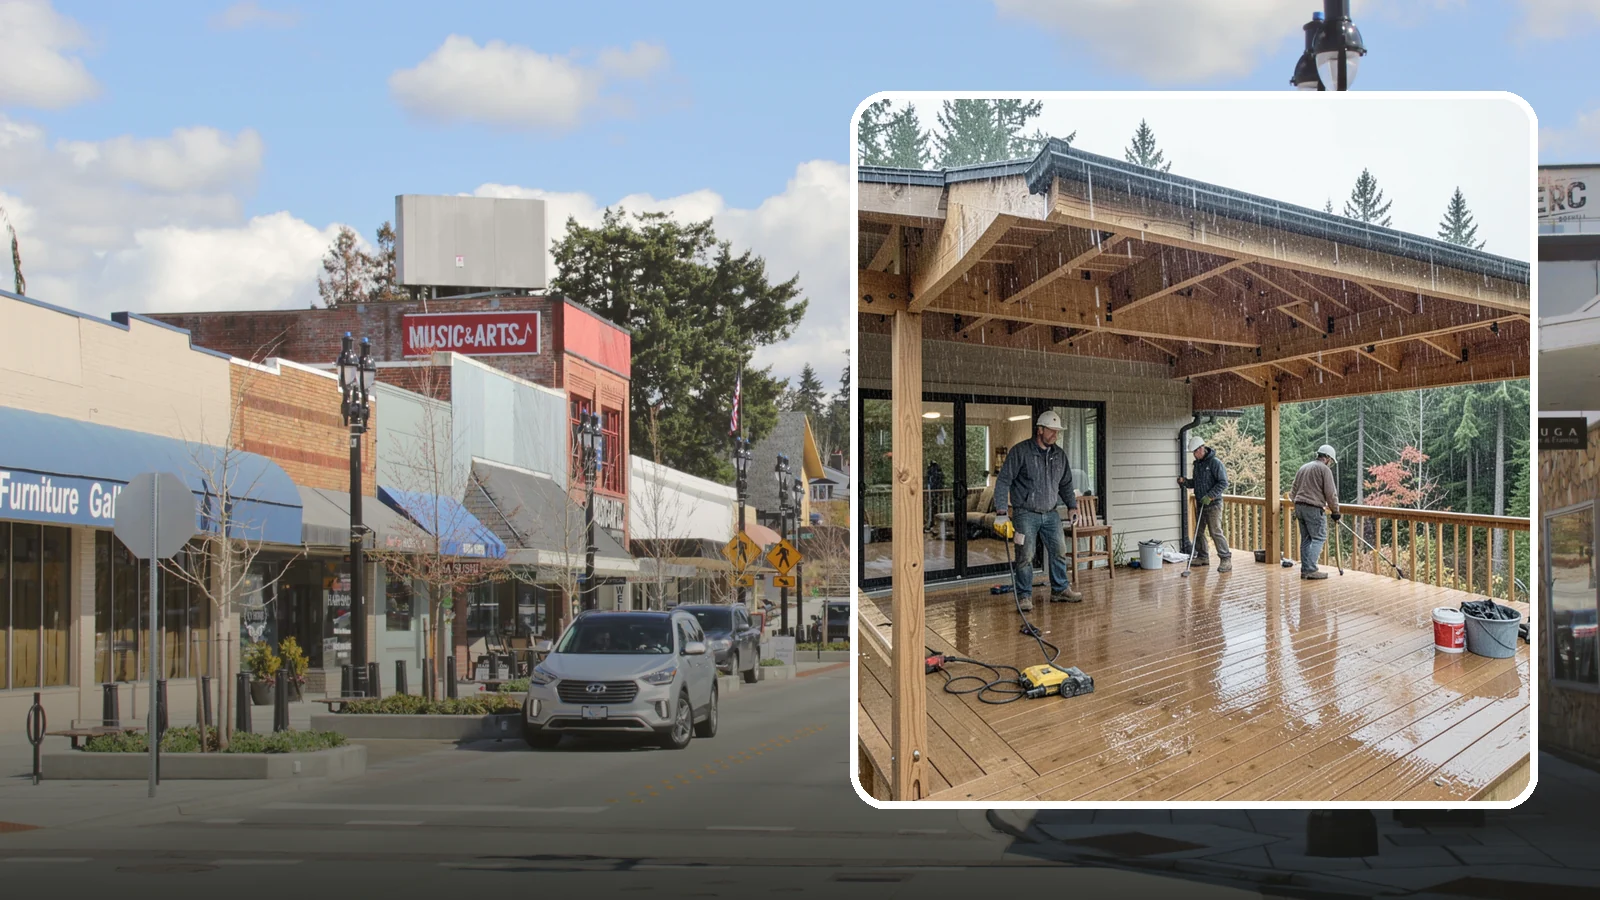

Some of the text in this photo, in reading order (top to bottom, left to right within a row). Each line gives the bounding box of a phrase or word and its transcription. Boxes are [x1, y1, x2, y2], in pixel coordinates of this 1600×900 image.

[409, 323, 520, 349] MUSIC&ARTS
[1540, 427, 1577, 436] UGA
[0, 471, 80, 516] Furniture
[452, 563, 480, 575] SUSHI
